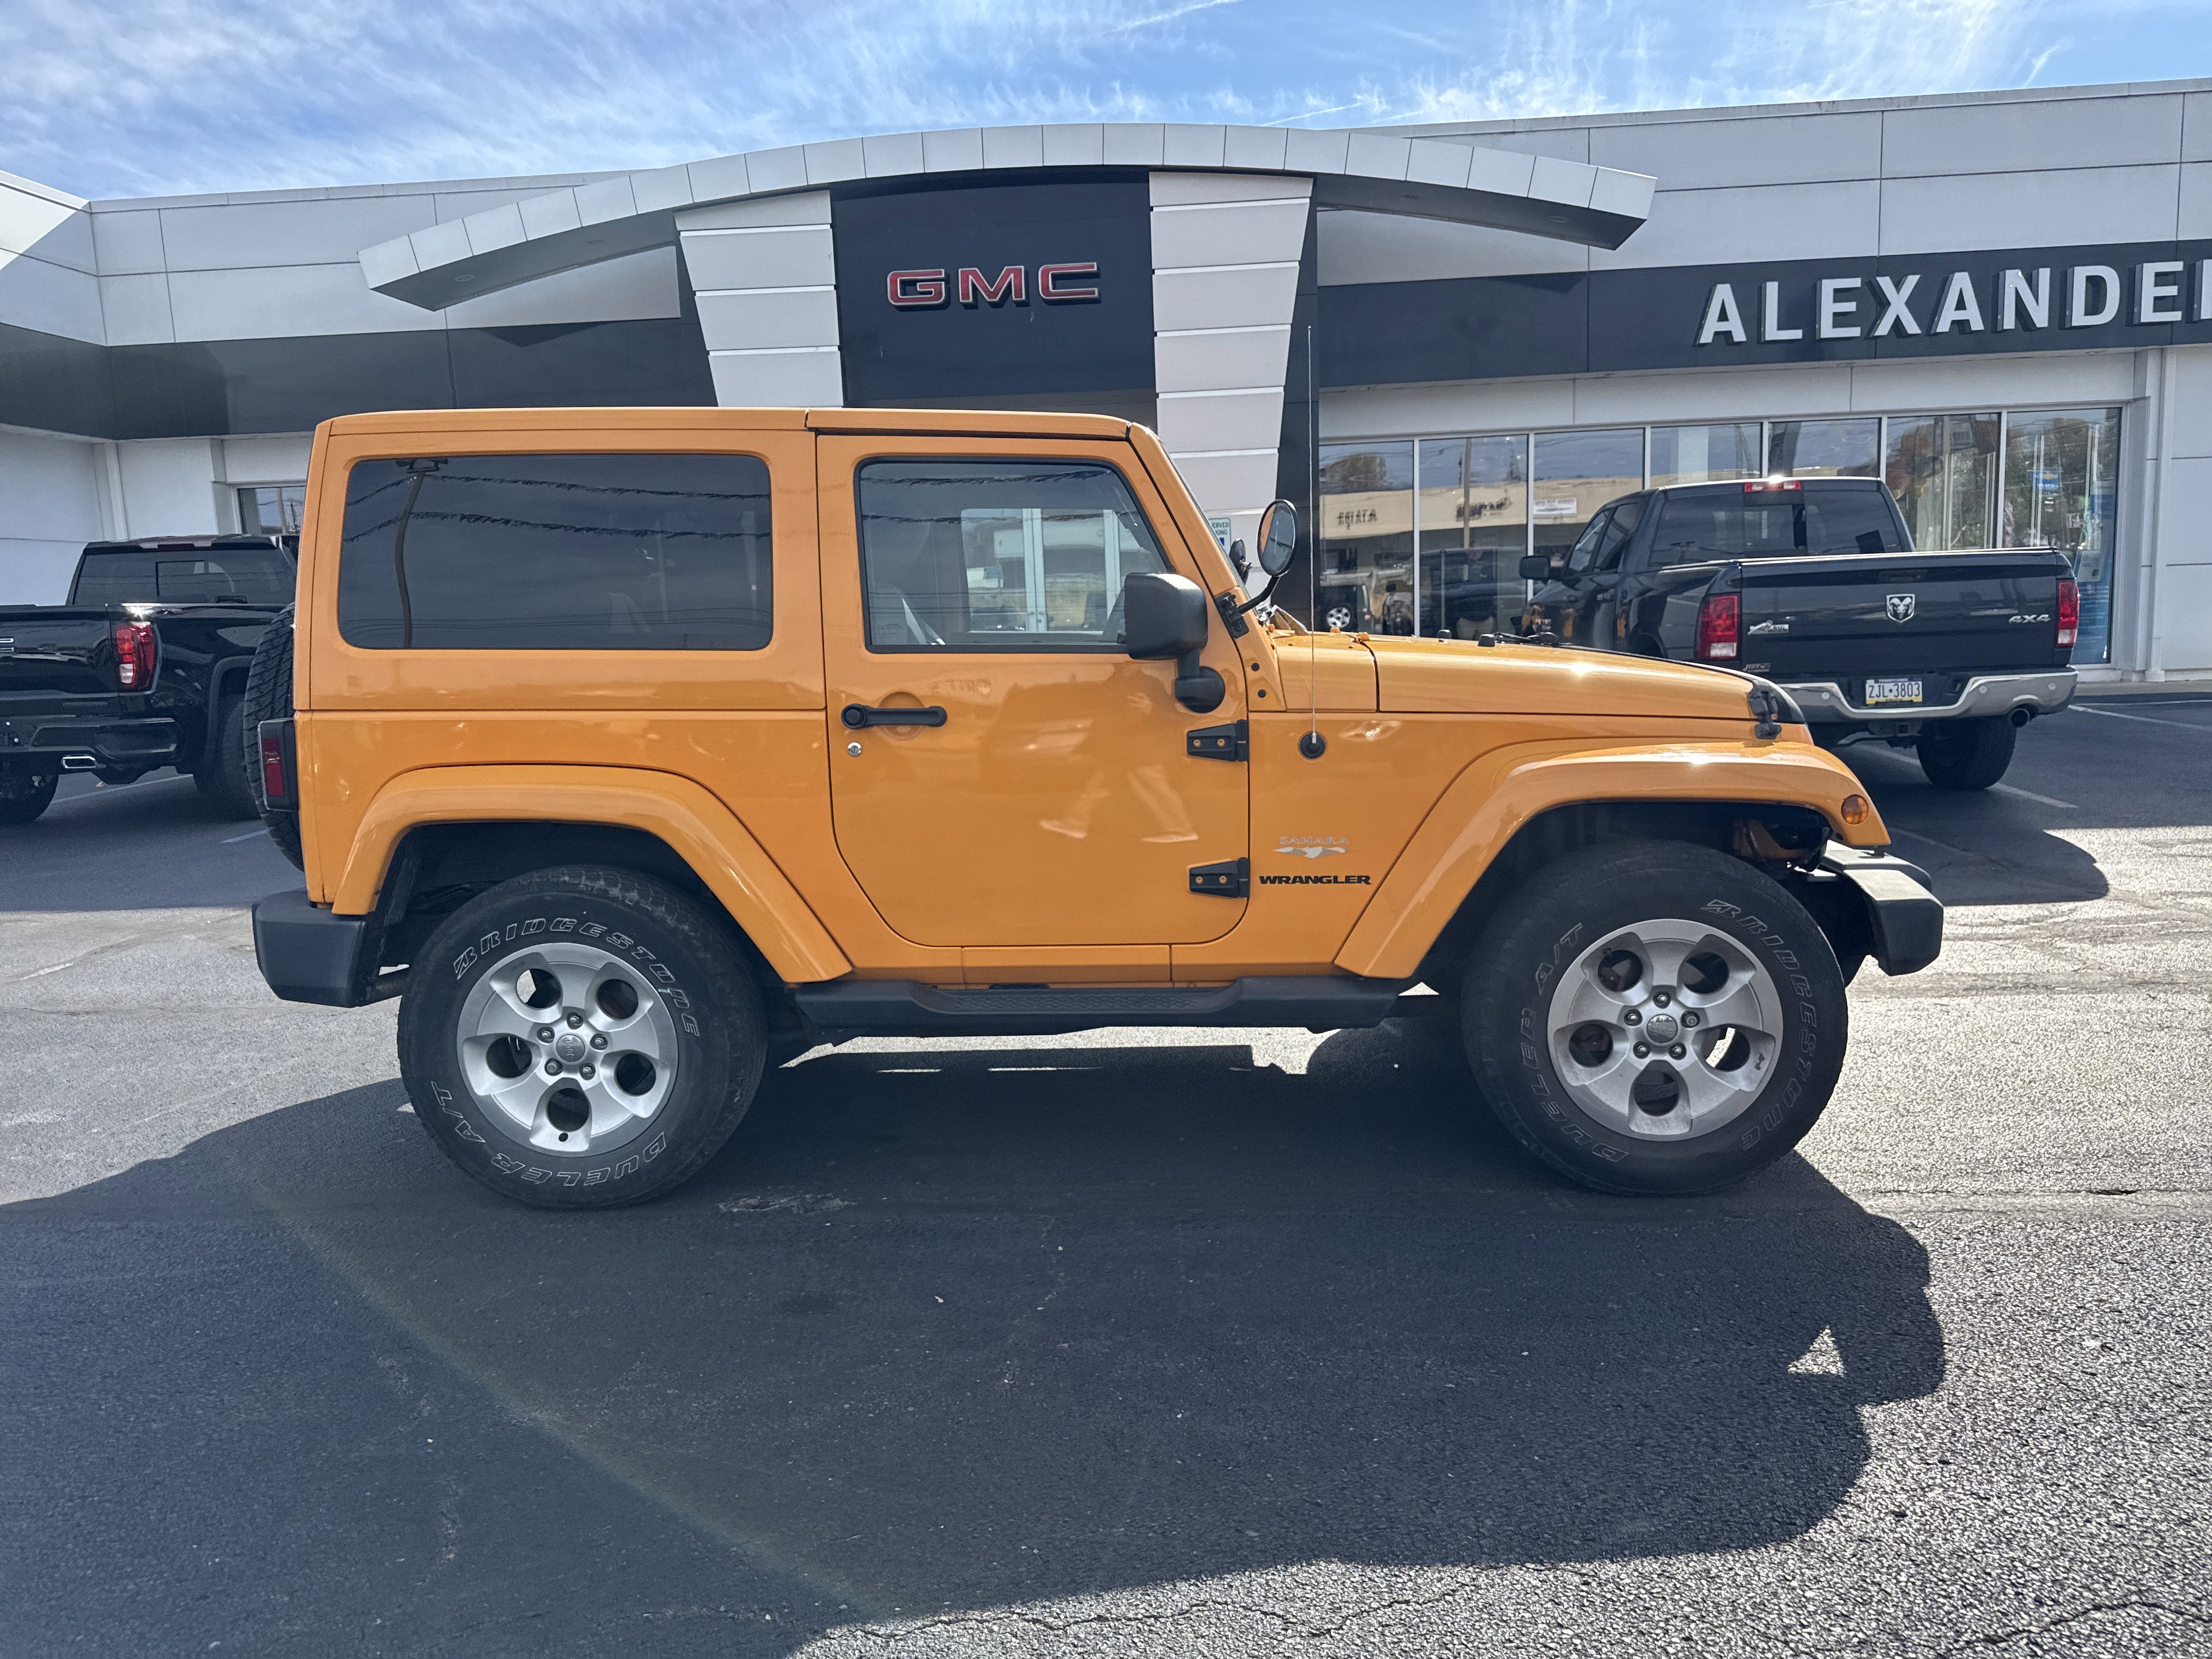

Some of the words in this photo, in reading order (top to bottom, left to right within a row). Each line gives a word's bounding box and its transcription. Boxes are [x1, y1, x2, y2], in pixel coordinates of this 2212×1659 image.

[887, 262, 1099, 306] GMC
[1694, 259, 2212, 345] ALEXANDE
[1279, 836, 1350, 845] SAHARA
[1259, 875, 1372, 885] WRANGLER
[453, 917, 700, 1037] BRIDGESTONE
[1700, 899, 1817, 1150] BRIDGESTONE
[1520, 1007, 1629, 1163] DUELER
[491, 1132, 667, 1187] DUELER
